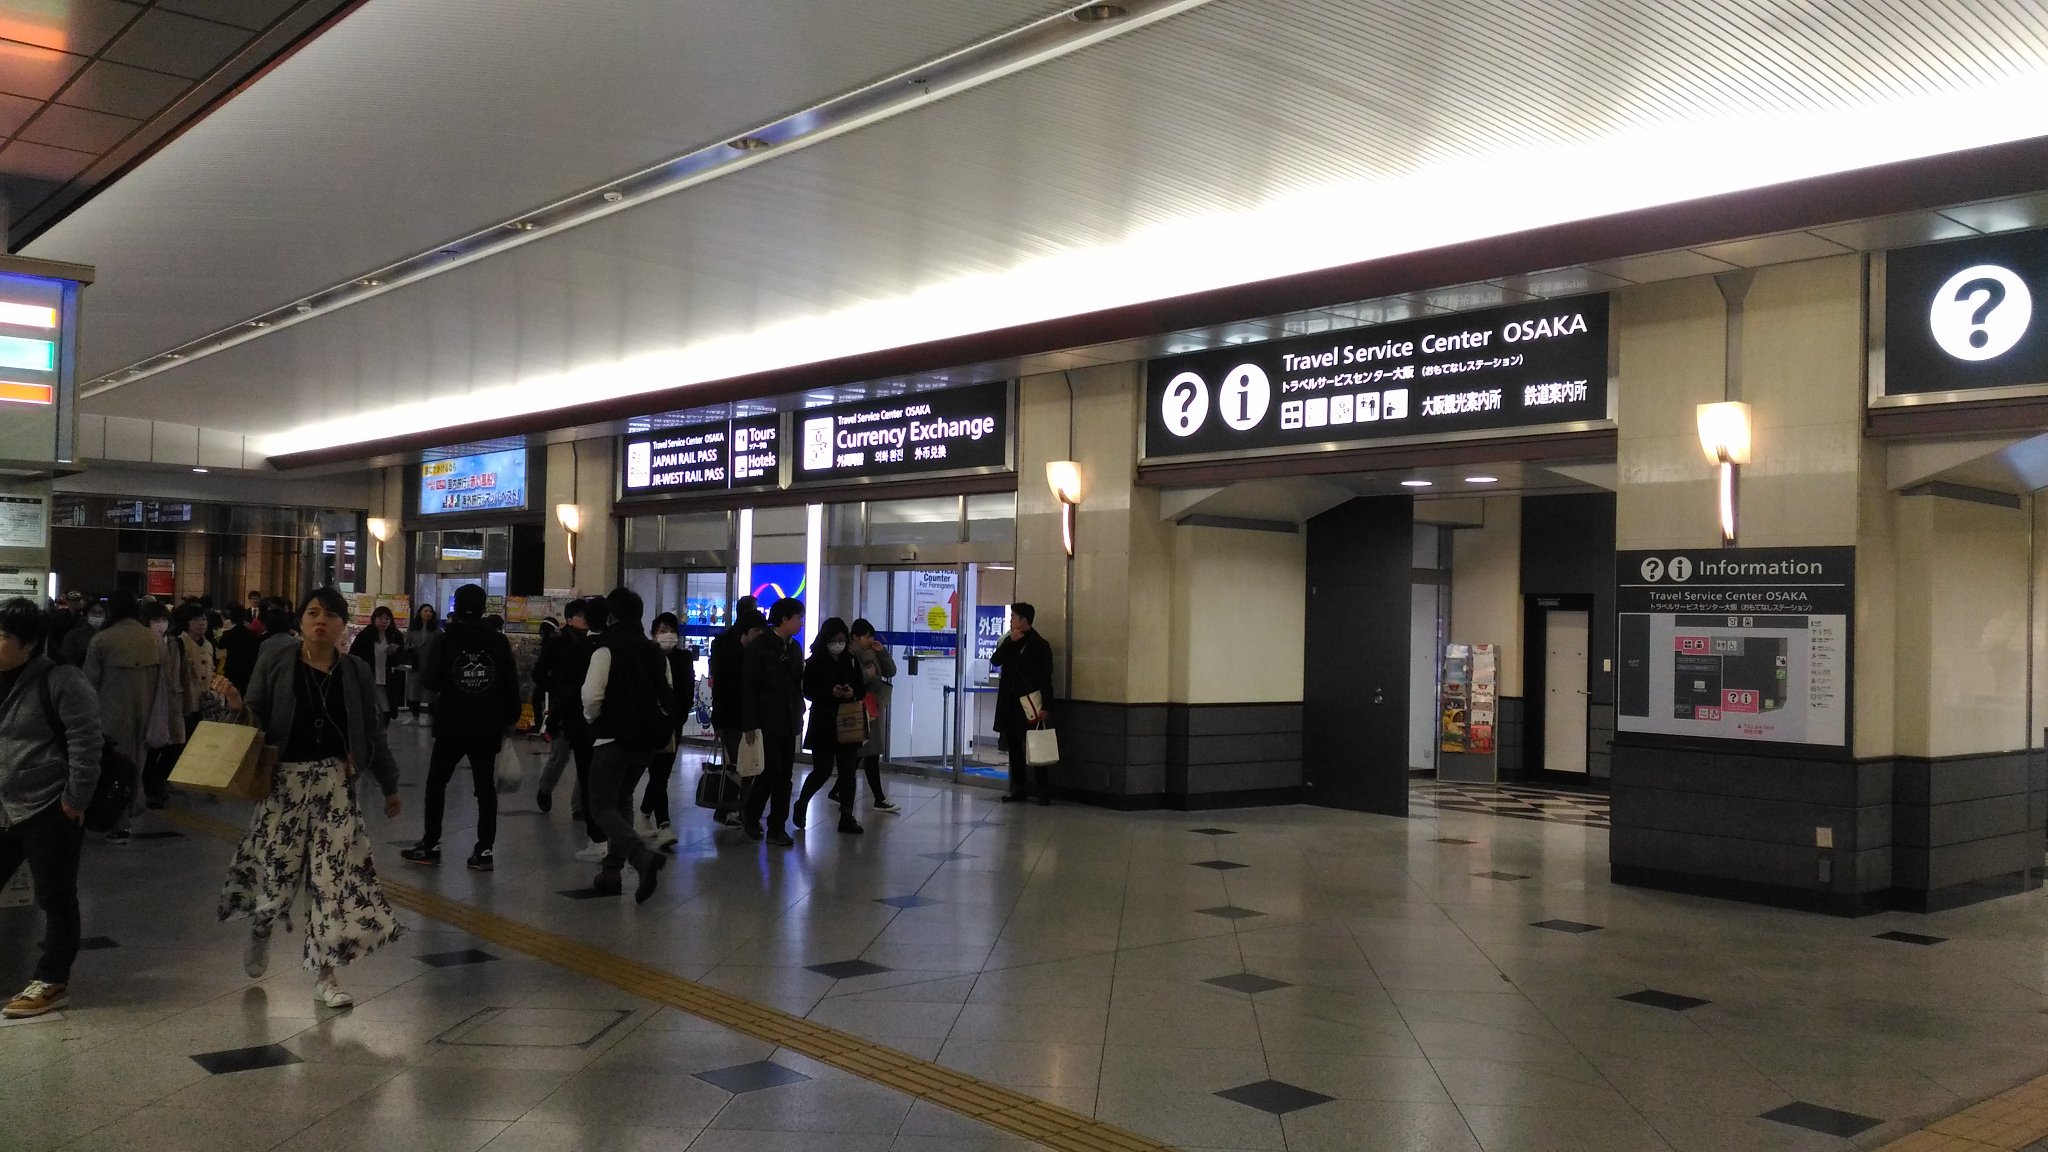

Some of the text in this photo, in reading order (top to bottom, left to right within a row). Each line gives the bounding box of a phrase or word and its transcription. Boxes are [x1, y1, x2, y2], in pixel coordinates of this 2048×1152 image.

[1283, 313, 1588, 372] Travel Service Center OSAKA
[1421, 380, 1588, 417] 大阪観光案内所 鉄道案内所
[838, 404, 931, 426] Travel Service Center OSAKA
[653, 432, 724, 450] Travel Service Center OSAKA
[749, 428, 776, 442] Tours
[836, 416, 995, 449] Currency Exchange
[652, 453, 677, 468] JAPAN
[678, 451, 696, 465] RAIL
[698, 449, 718, 463] PASS
[749, 451, 776, 469] Hotels
[652, 467, 724, 487] JR-WEST RAIL PASS
[1699, 559, 1823, 576] Information
[923, 573, 951, 582] Counter
[1650, 591, 1808, 601] Travel Service Center OSAKA
[979, 617, 1005, 636] 外貨
